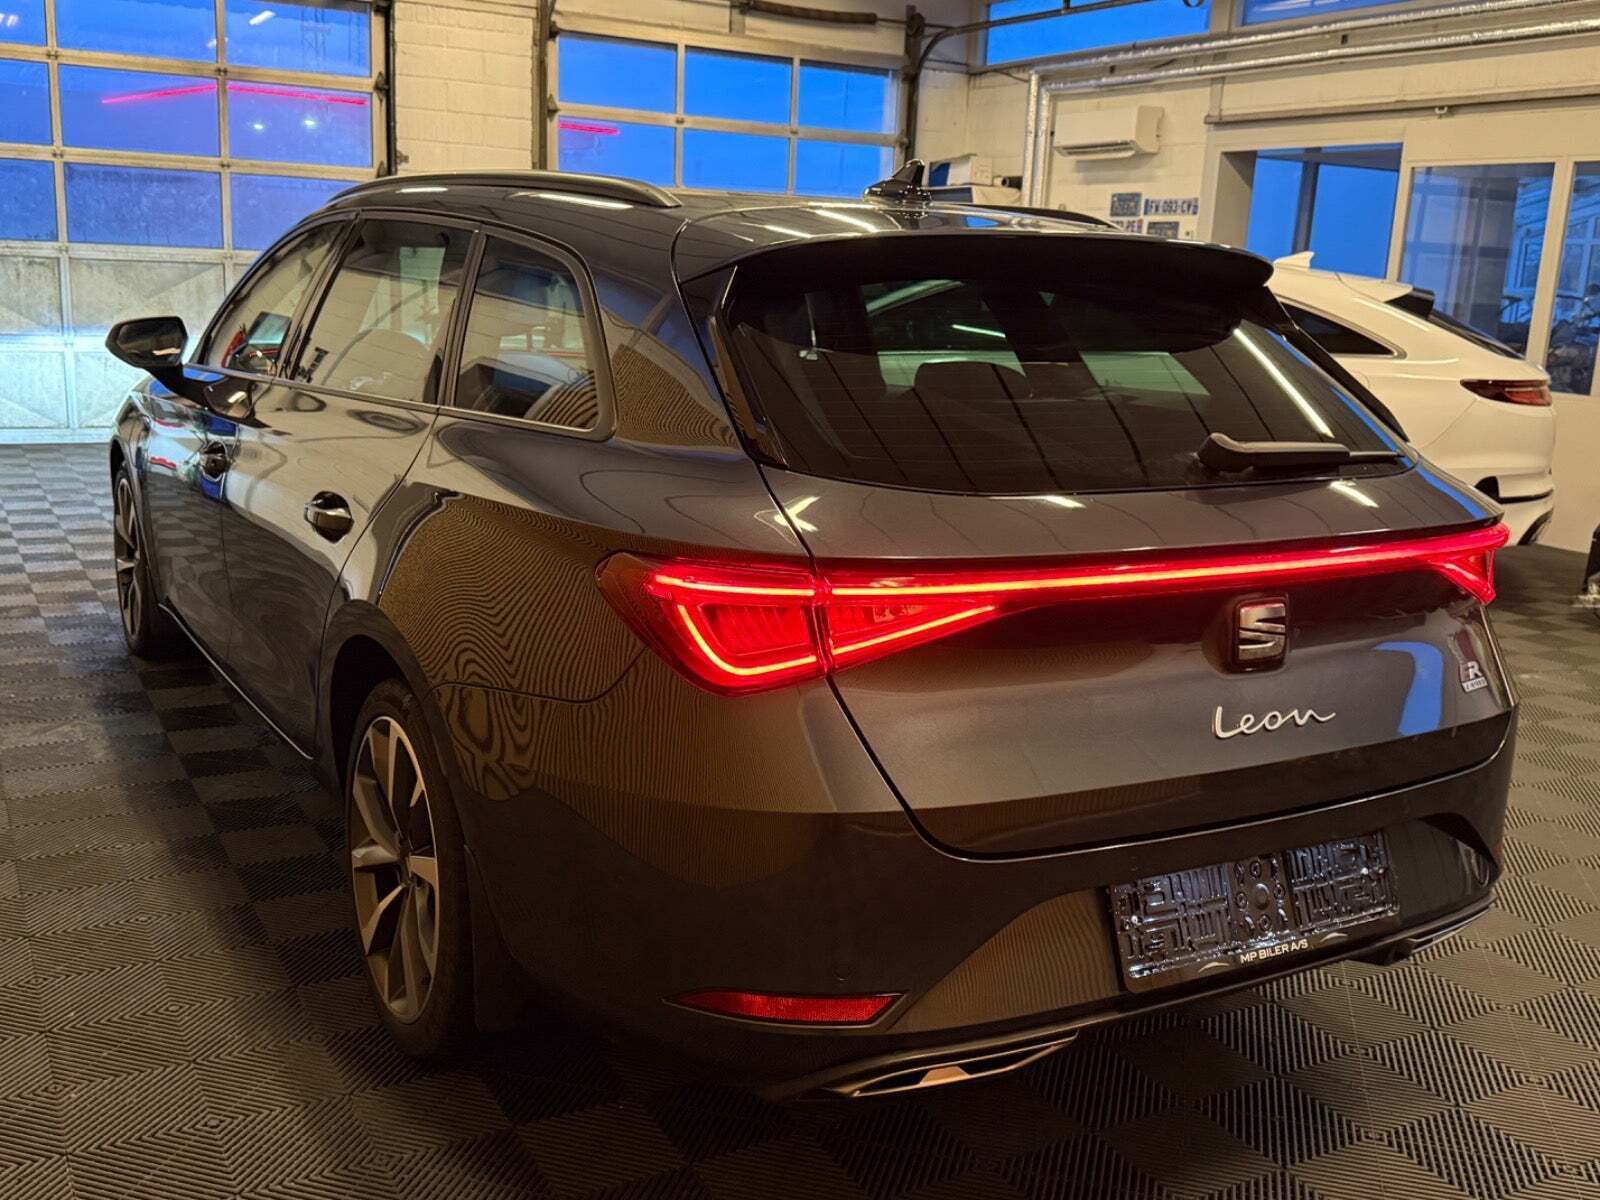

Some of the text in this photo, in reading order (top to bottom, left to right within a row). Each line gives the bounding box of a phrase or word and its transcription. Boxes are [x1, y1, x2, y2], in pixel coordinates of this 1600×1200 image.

[1213, 705, 1337, 737] Leon
[1240, 939, 1308, 963] MP BILER A/S
